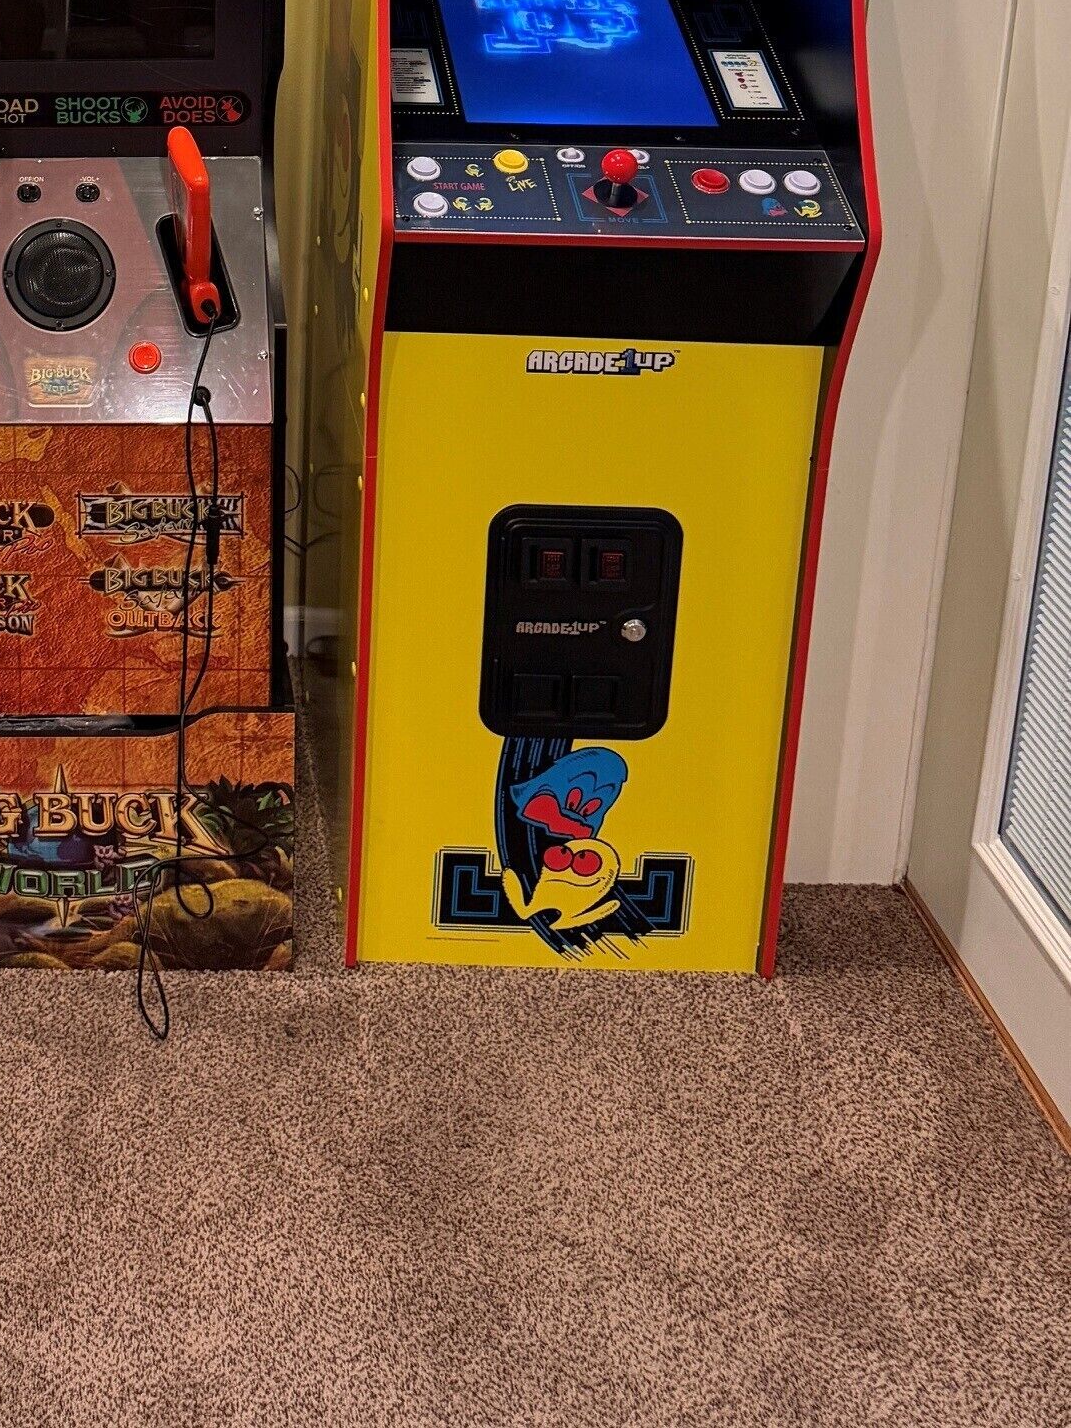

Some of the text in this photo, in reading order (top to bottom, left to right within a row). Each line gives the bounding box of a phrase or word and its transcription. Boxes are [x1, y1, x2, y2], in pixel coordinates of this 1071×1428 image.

[55, 97, 121, 110] SHOOT
[159, 96, 216, 109] AVOID
[57, 110, 121, 124] BUCKS
[163, 110, 216, 123] DOES
[433, 182, 486, 191] START GAME
[508, 177, 537, 192] LIVE
[29, 367, 92, 383] BIG BUCK
[106, 500, 148, 527] BIG
[105, 568, 147, 594] BIG
[34, 792, 231, 856] BUCK
